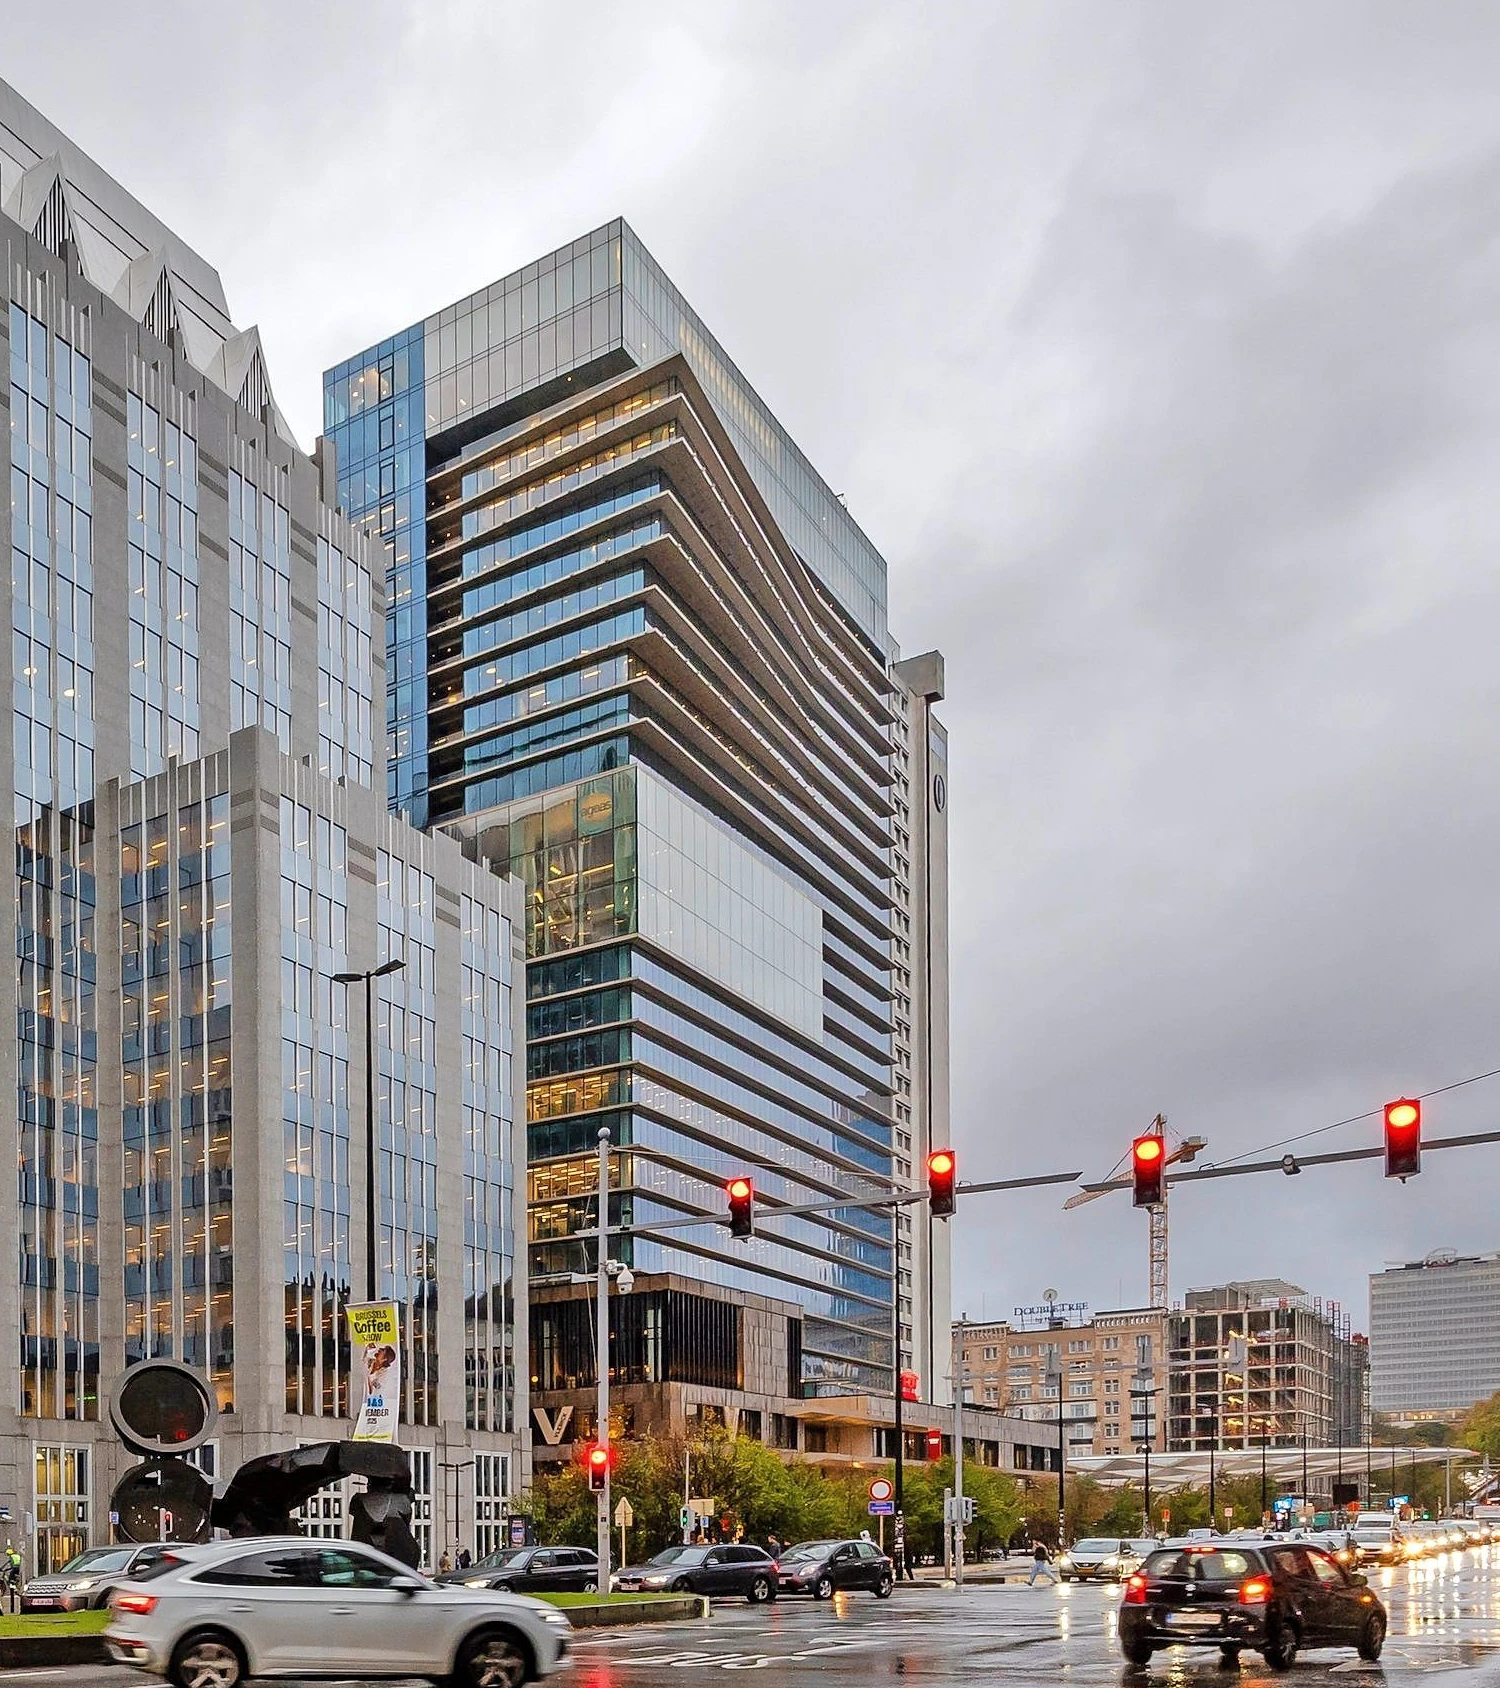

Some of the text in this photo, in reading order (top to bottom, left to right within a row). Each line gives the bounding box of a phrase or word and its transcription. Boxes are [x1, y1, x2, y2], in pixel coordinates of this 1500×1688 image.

[581, 800, 612, 818] ageas
[355, 1310, 387, 1320] BRUSSELS
[354, 1319, 391, 1334] Coffee
